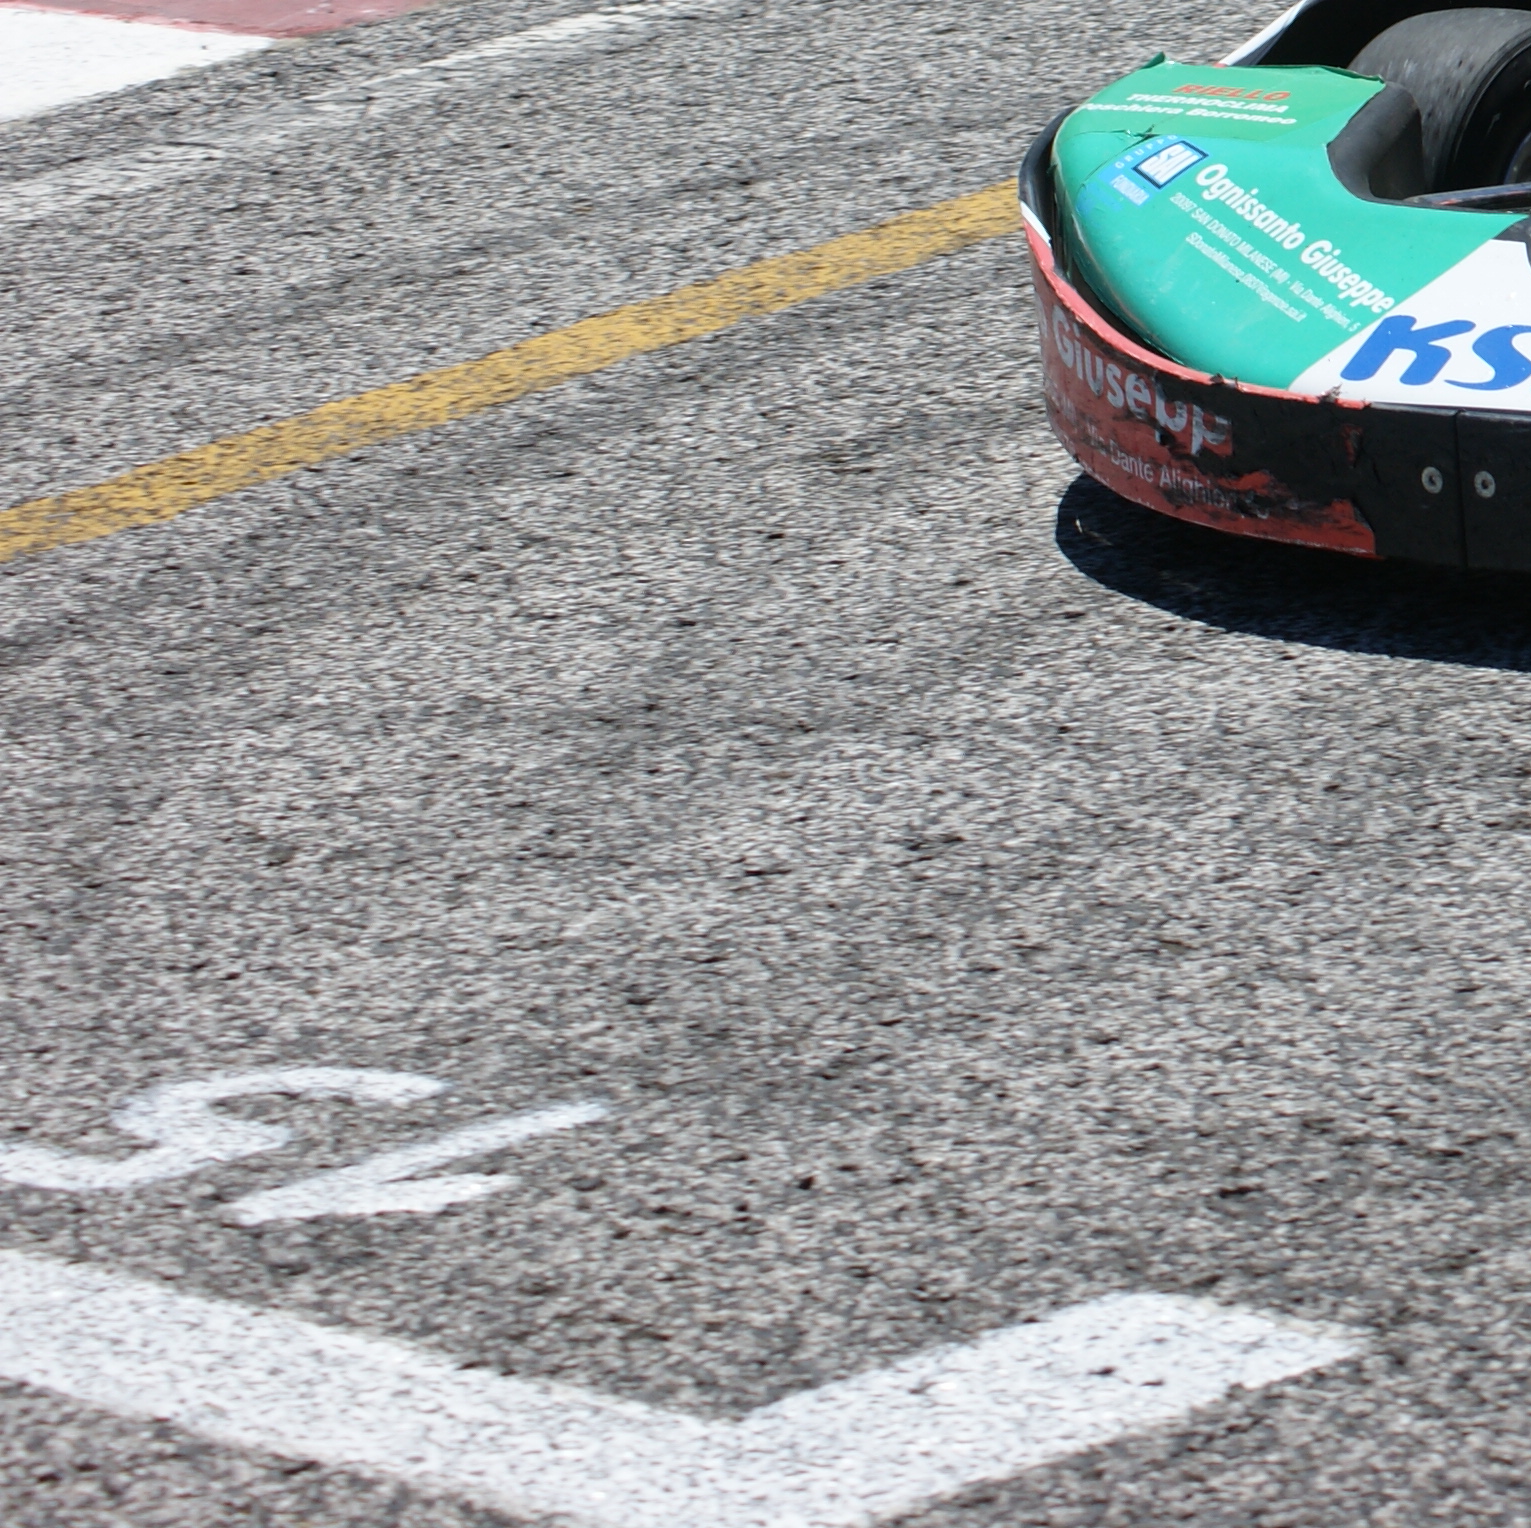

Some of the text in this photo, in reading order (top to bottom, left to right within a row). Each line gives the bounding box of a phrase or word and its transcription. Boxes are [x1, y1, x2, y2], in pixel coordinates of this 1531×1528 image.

[1126, 92, 1290, 114] THERMOCLIMA
[1172, 83, 1292, 102] RIELLO
[1083, 102, 1298, 125] eschiera Borromeo
[1136, 143, 1200, 186] SAI
[1194, 162, 1306, 251] Ognissanto
[1300, 239, 1396, 314] Giuseppe
[1206, 218, 1242, 248] DONATO
[1233, 240, 1278, 274] MILANESE
[1110, 442, 1154, 483] Dante
